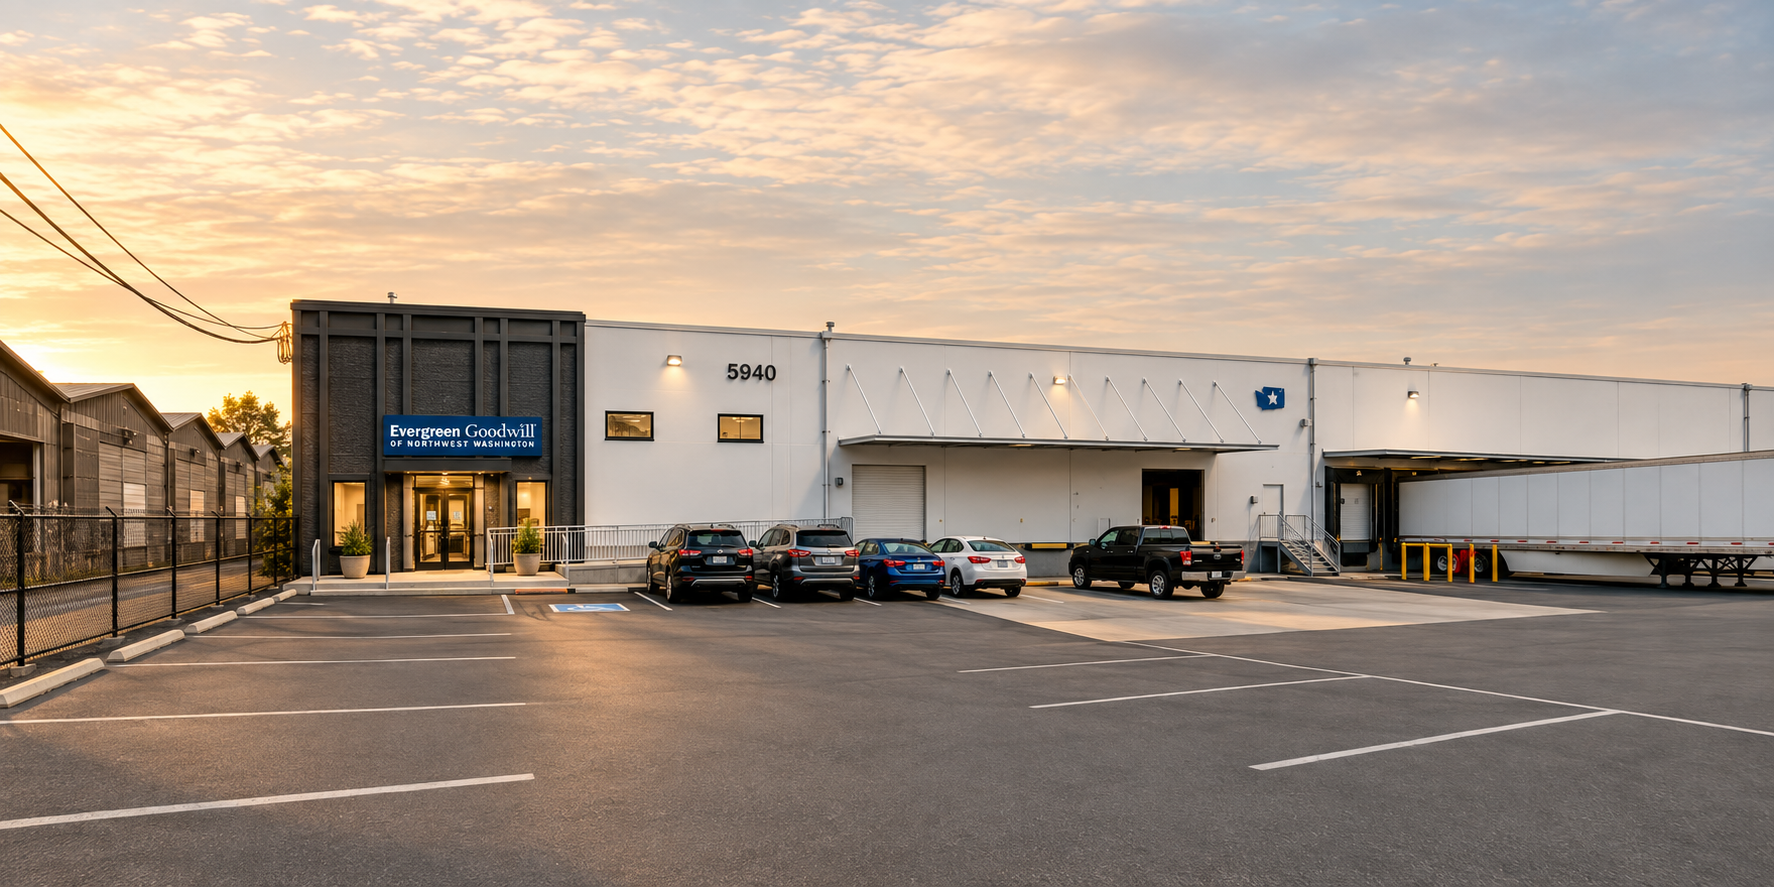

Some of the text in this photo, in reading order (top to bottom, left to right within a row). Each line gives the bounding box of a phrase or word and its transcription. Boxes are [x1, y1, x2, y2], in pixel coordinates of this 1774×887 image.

[727, 363, 776, 381] 5940
[390, 422, 536, 439] Evergreen Goodwill
[390, 440, 403, 448] OF
[407, 440, 469, 448] NORTHWEST
